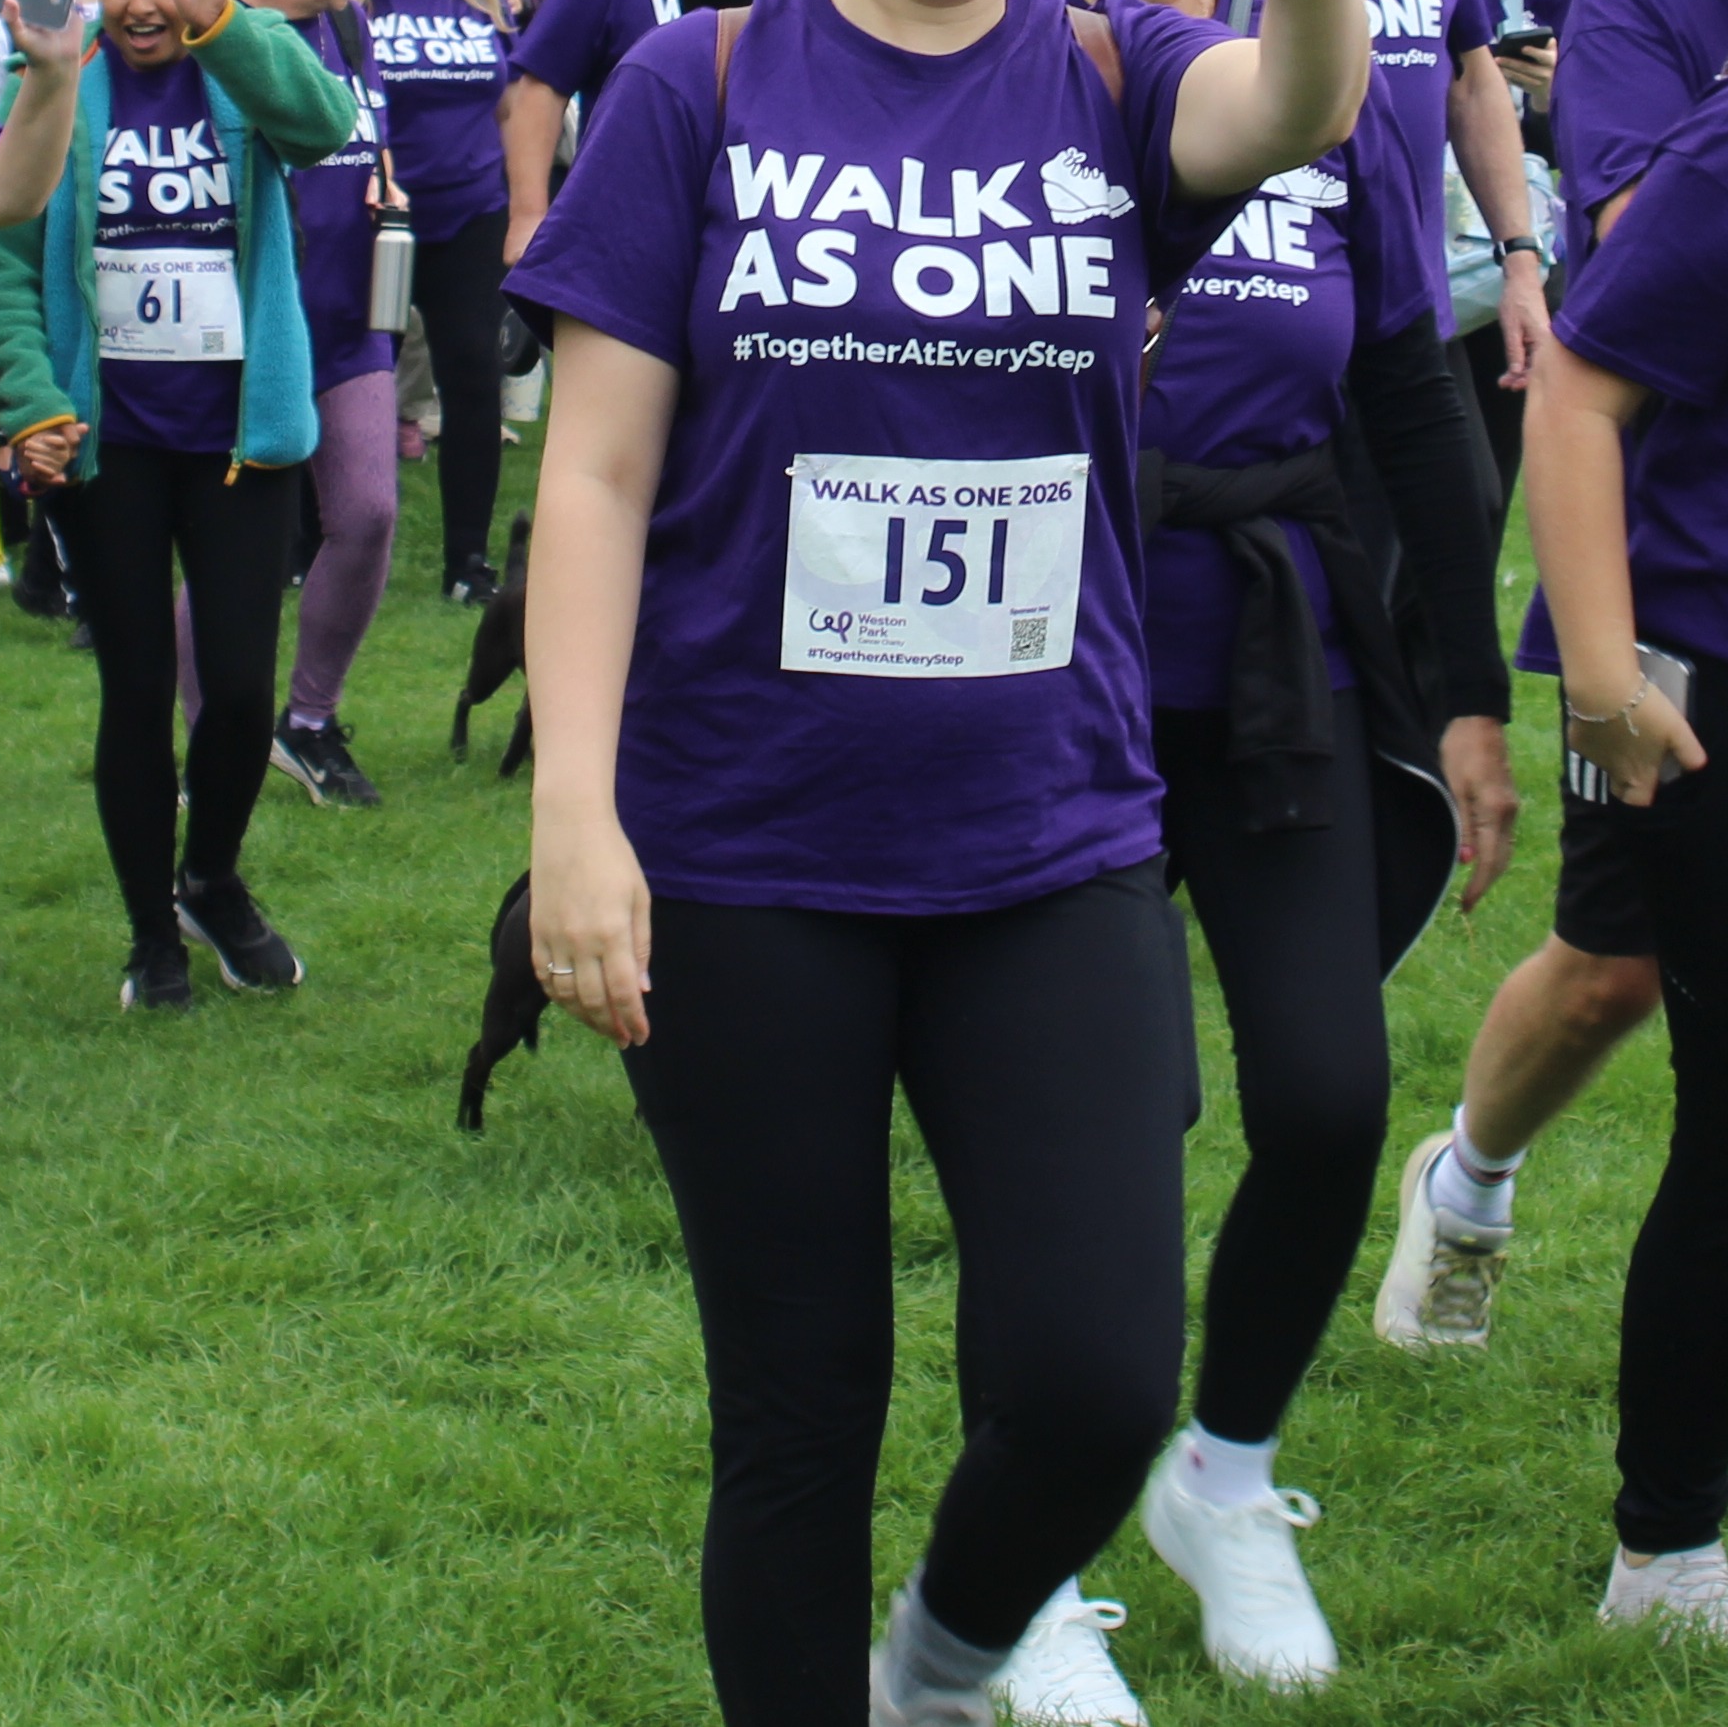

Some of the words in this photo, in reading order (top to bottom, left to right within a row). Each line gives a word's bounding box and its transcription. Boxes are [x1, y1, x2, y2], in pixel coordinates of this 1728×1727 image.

[367, 13, 463, 41] WALK
[373, 38, 419, 64] AS
[424, 38, 498, 65] ONE
[378, 69, 494, 82] TogetherAtEveryStep
[104, 119, 214, 168] ALK
[98, 170, 133, 215] S
[147, 162, 232, 215] ON
[726, 142, 1034, 238] WALK
[1210, 199, 1316, 270] NE
[95, 261, 137, 273] WALK
[140, 262, 161, 274] AS
[163, 261, 195, 273] ONE
[196, 261, 227, 273] 2026
[718, 228, 858, 313] AS
[892, 235, 1117, 319] ONE
[136, 279, 182, 323] 61
[733, 331, 1096, 374] #TogetherAtEveryStep
[811, 479, 902, 505] WALK
[908, 485, 946, 506] AS
[954, 486, 1013, 507] ONE
[1018, 480, 1072, 506] 2026
[883, 517, 1009, 607] 151
[858, 613, 907, 627] Weston
[859, 626, 888, 638] Park
[807, 647, 964, 667] #TogetherAtEveryStep
